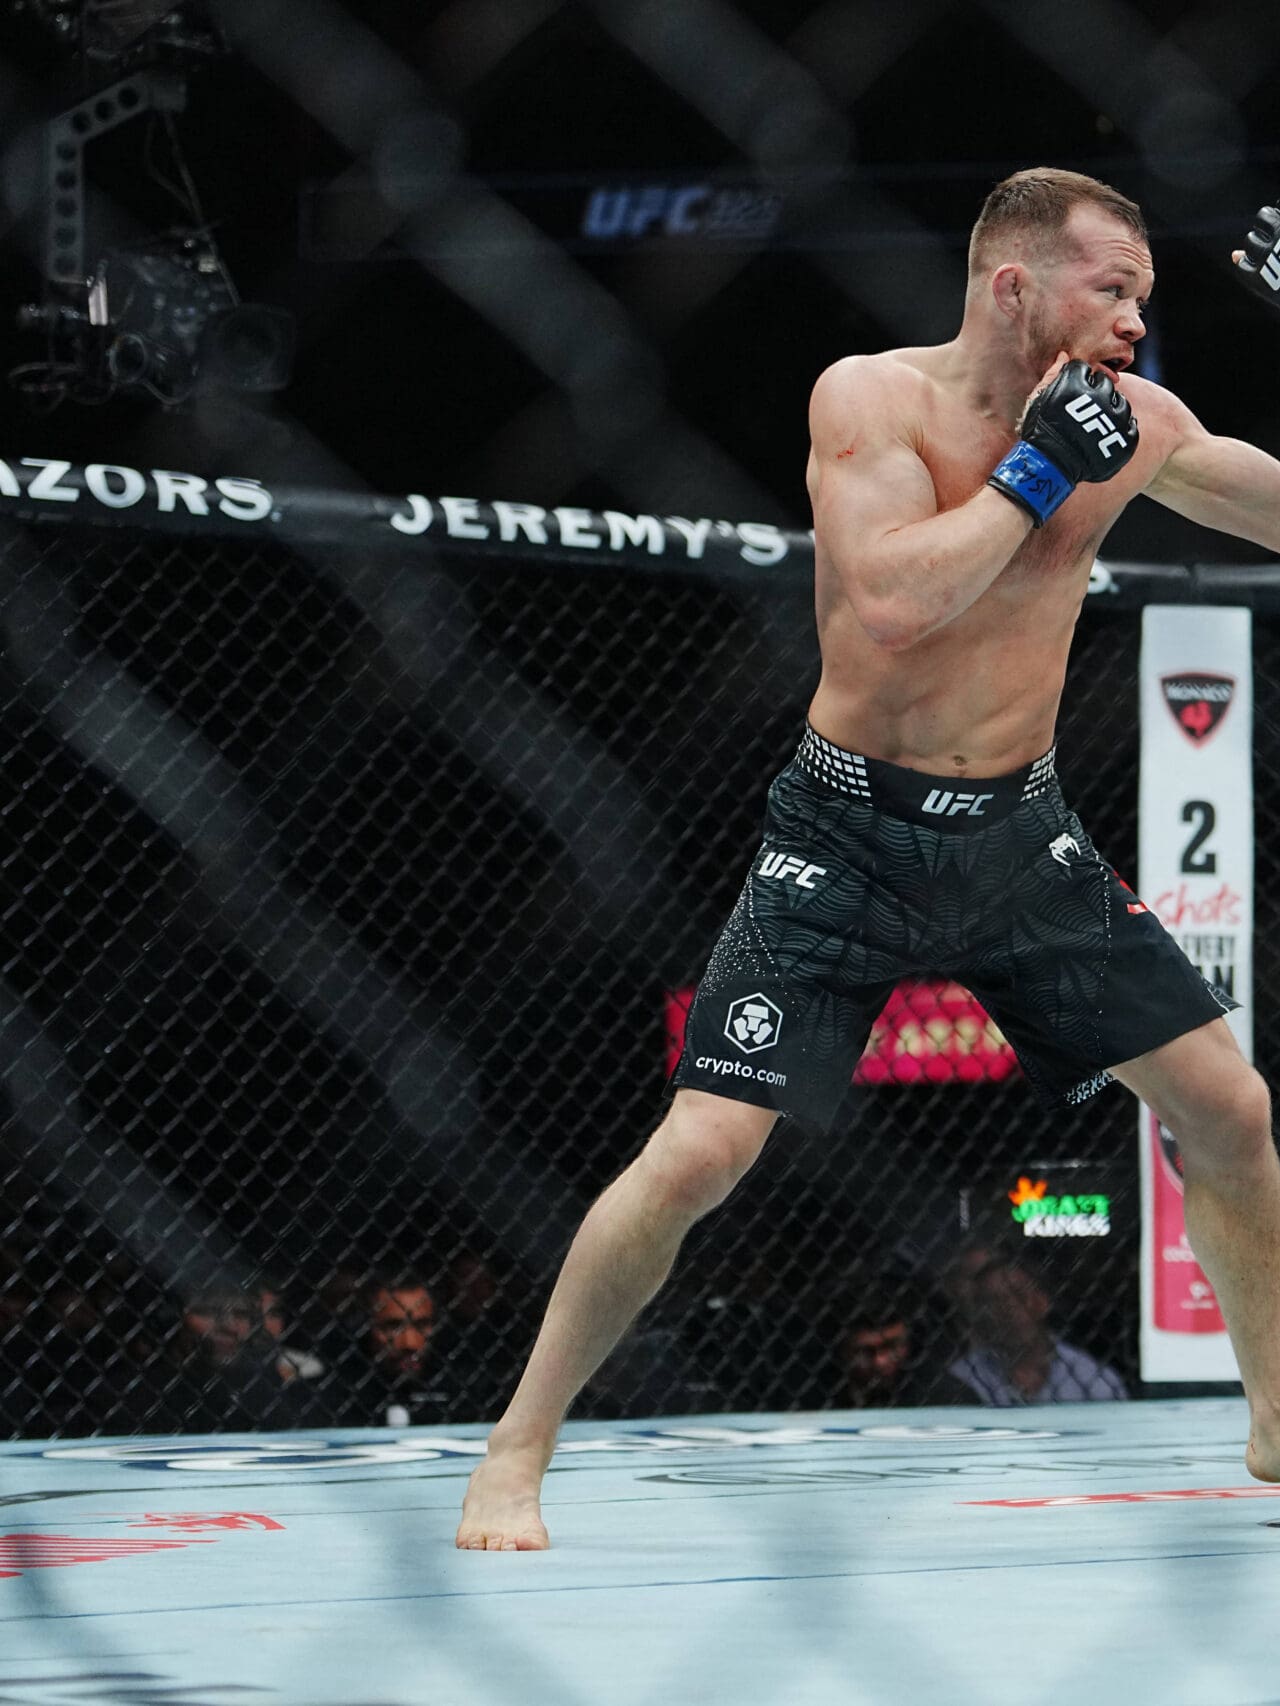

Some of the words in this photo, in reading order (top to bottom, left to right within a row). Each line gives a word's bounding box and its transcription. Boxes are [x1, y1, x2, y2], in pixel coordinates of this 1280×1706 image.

[584, 184, 709, 238] UFC
[1064, 393, 1128, 459] UFC
[390, 494, 789, 566] JEREMY'S
[921, 788, 996, 816] UFC
[1181, 800, 1217, 874] 2
[758, 852, 827, 890] UFC
[695, 1056, 787, 1087] crypto.com
